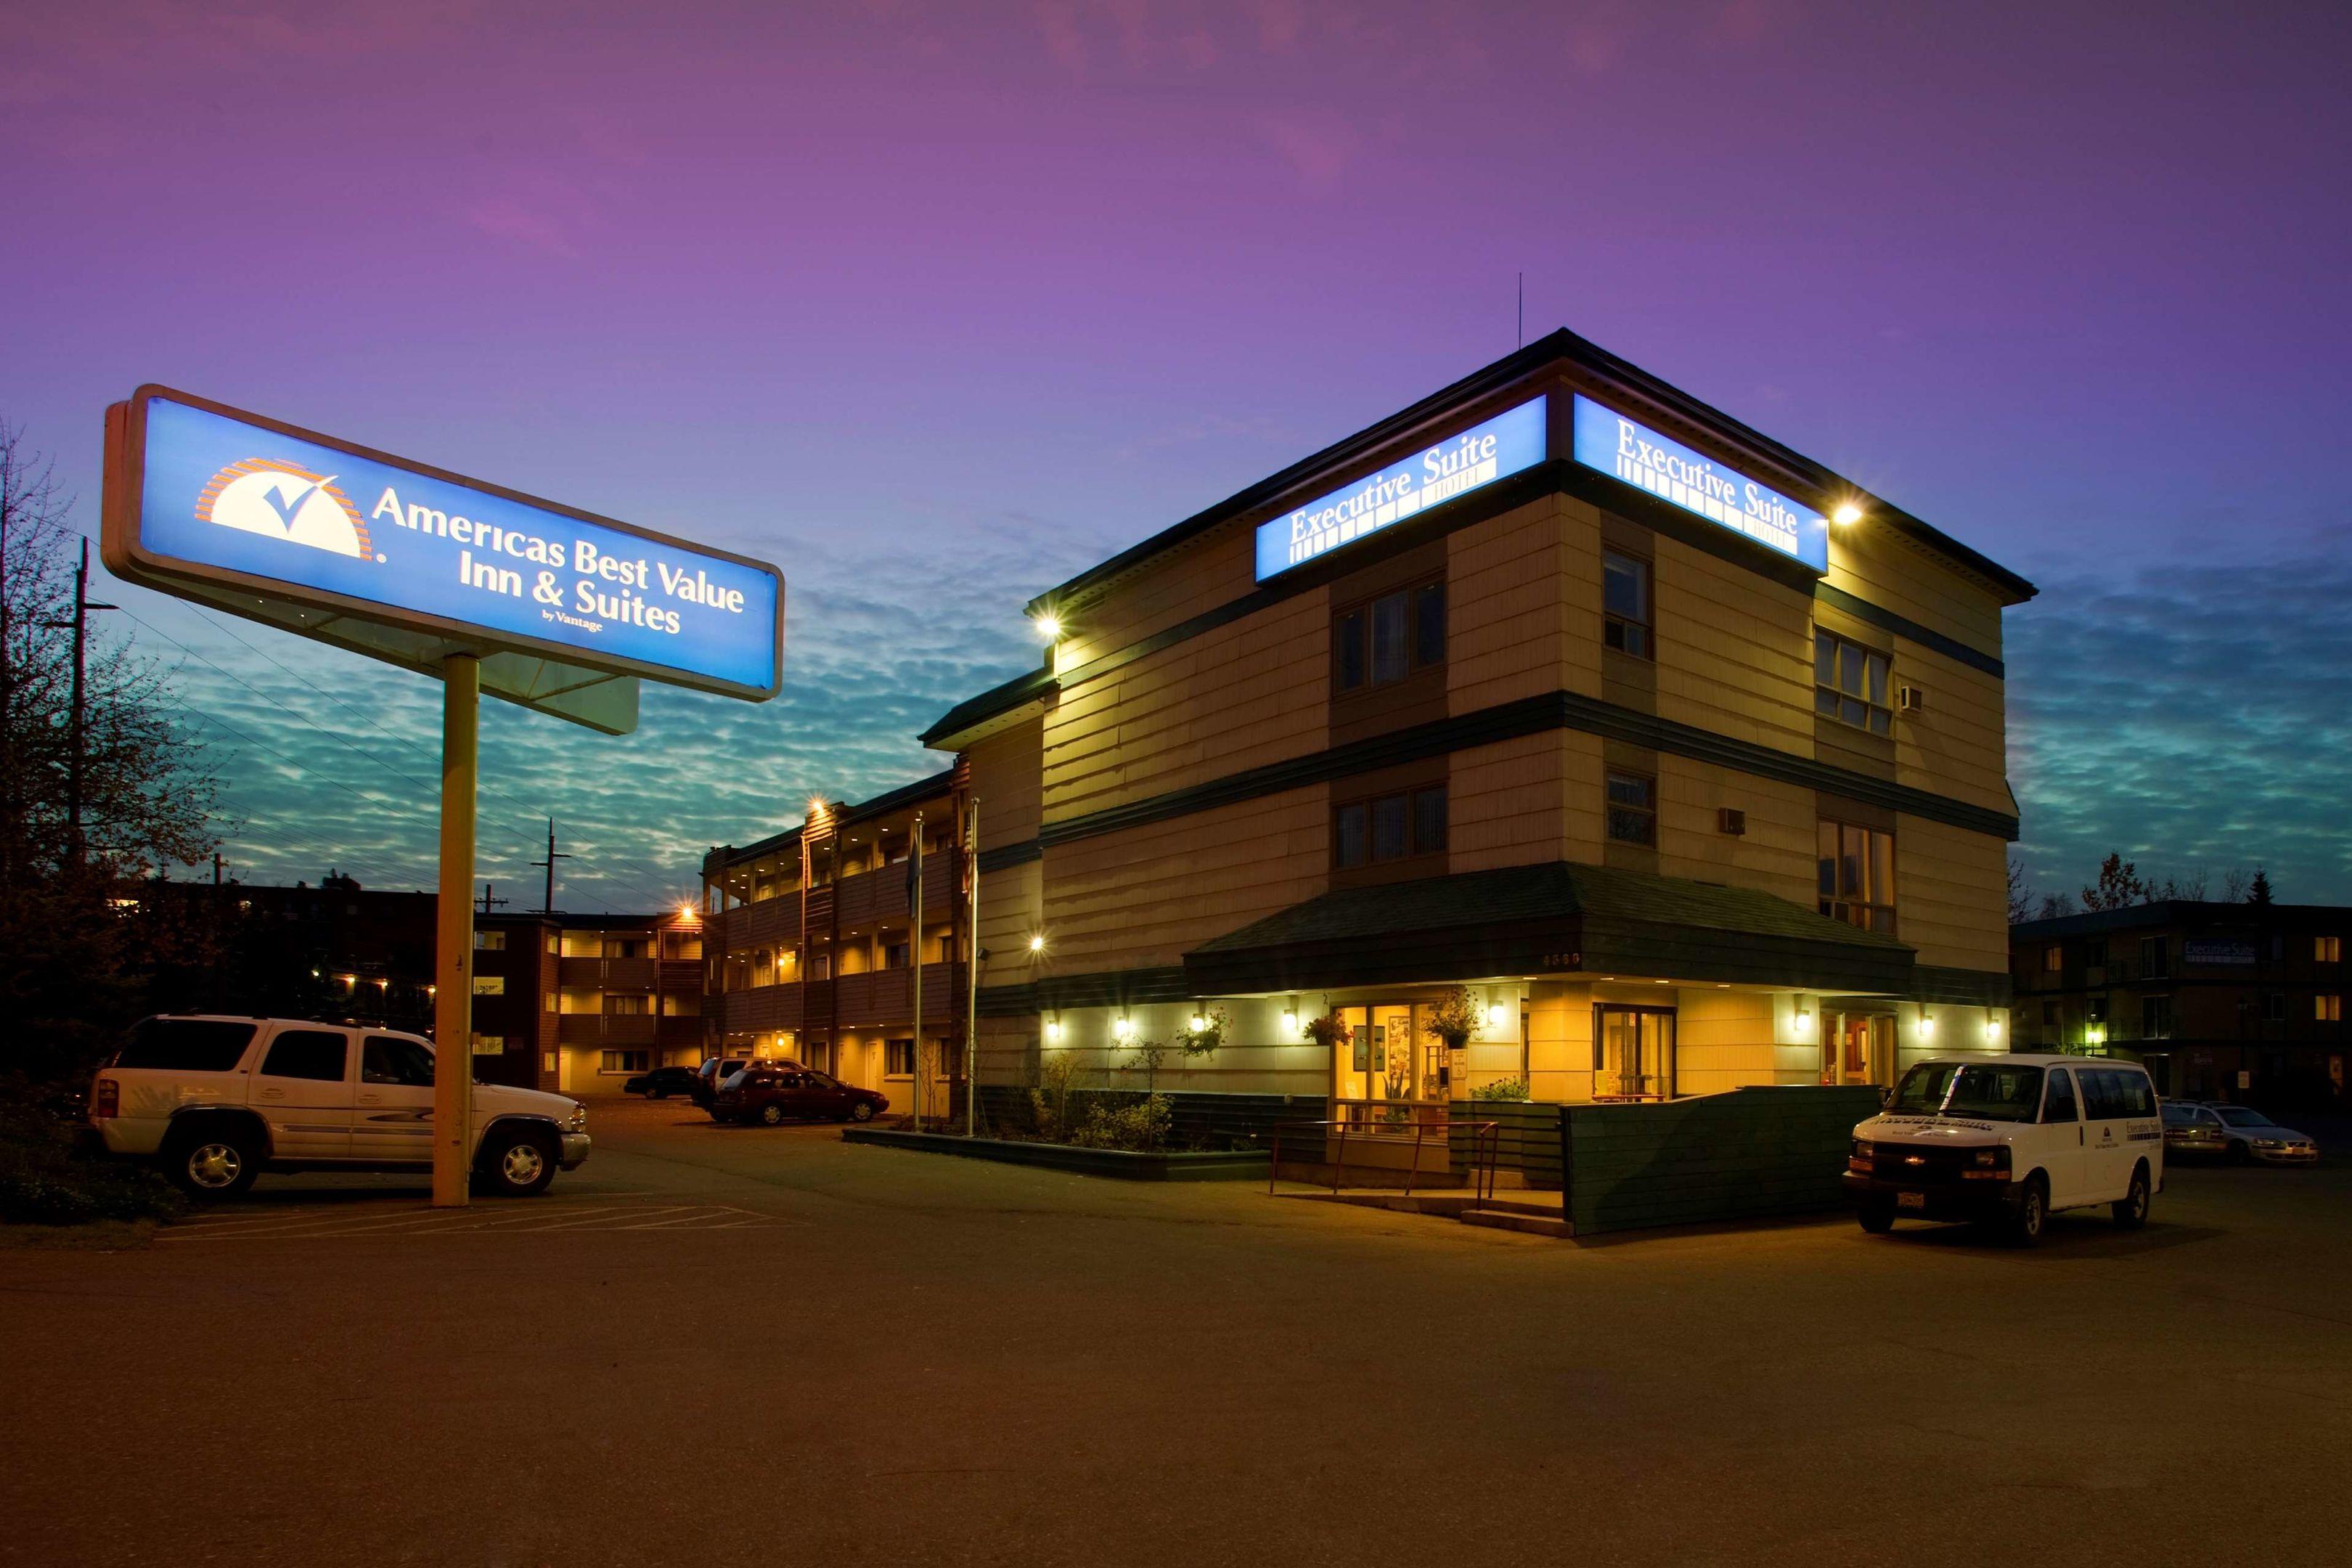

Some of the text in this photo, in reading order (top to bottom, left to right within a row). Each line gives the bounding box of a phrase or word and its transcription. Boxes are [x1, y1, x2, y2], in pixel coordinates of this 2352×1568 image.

[1291, 435, 1497, 544] Executive Suite
[1435, 467, 1479, 499] HOTEL
[1617, 418, 1797, 534] Executive Suite
[371, 486, 745, 613] Americas Best Value
[460, 550, 680, 634] Inn & Suites
[542, 609, 603, 633] by Vantage
